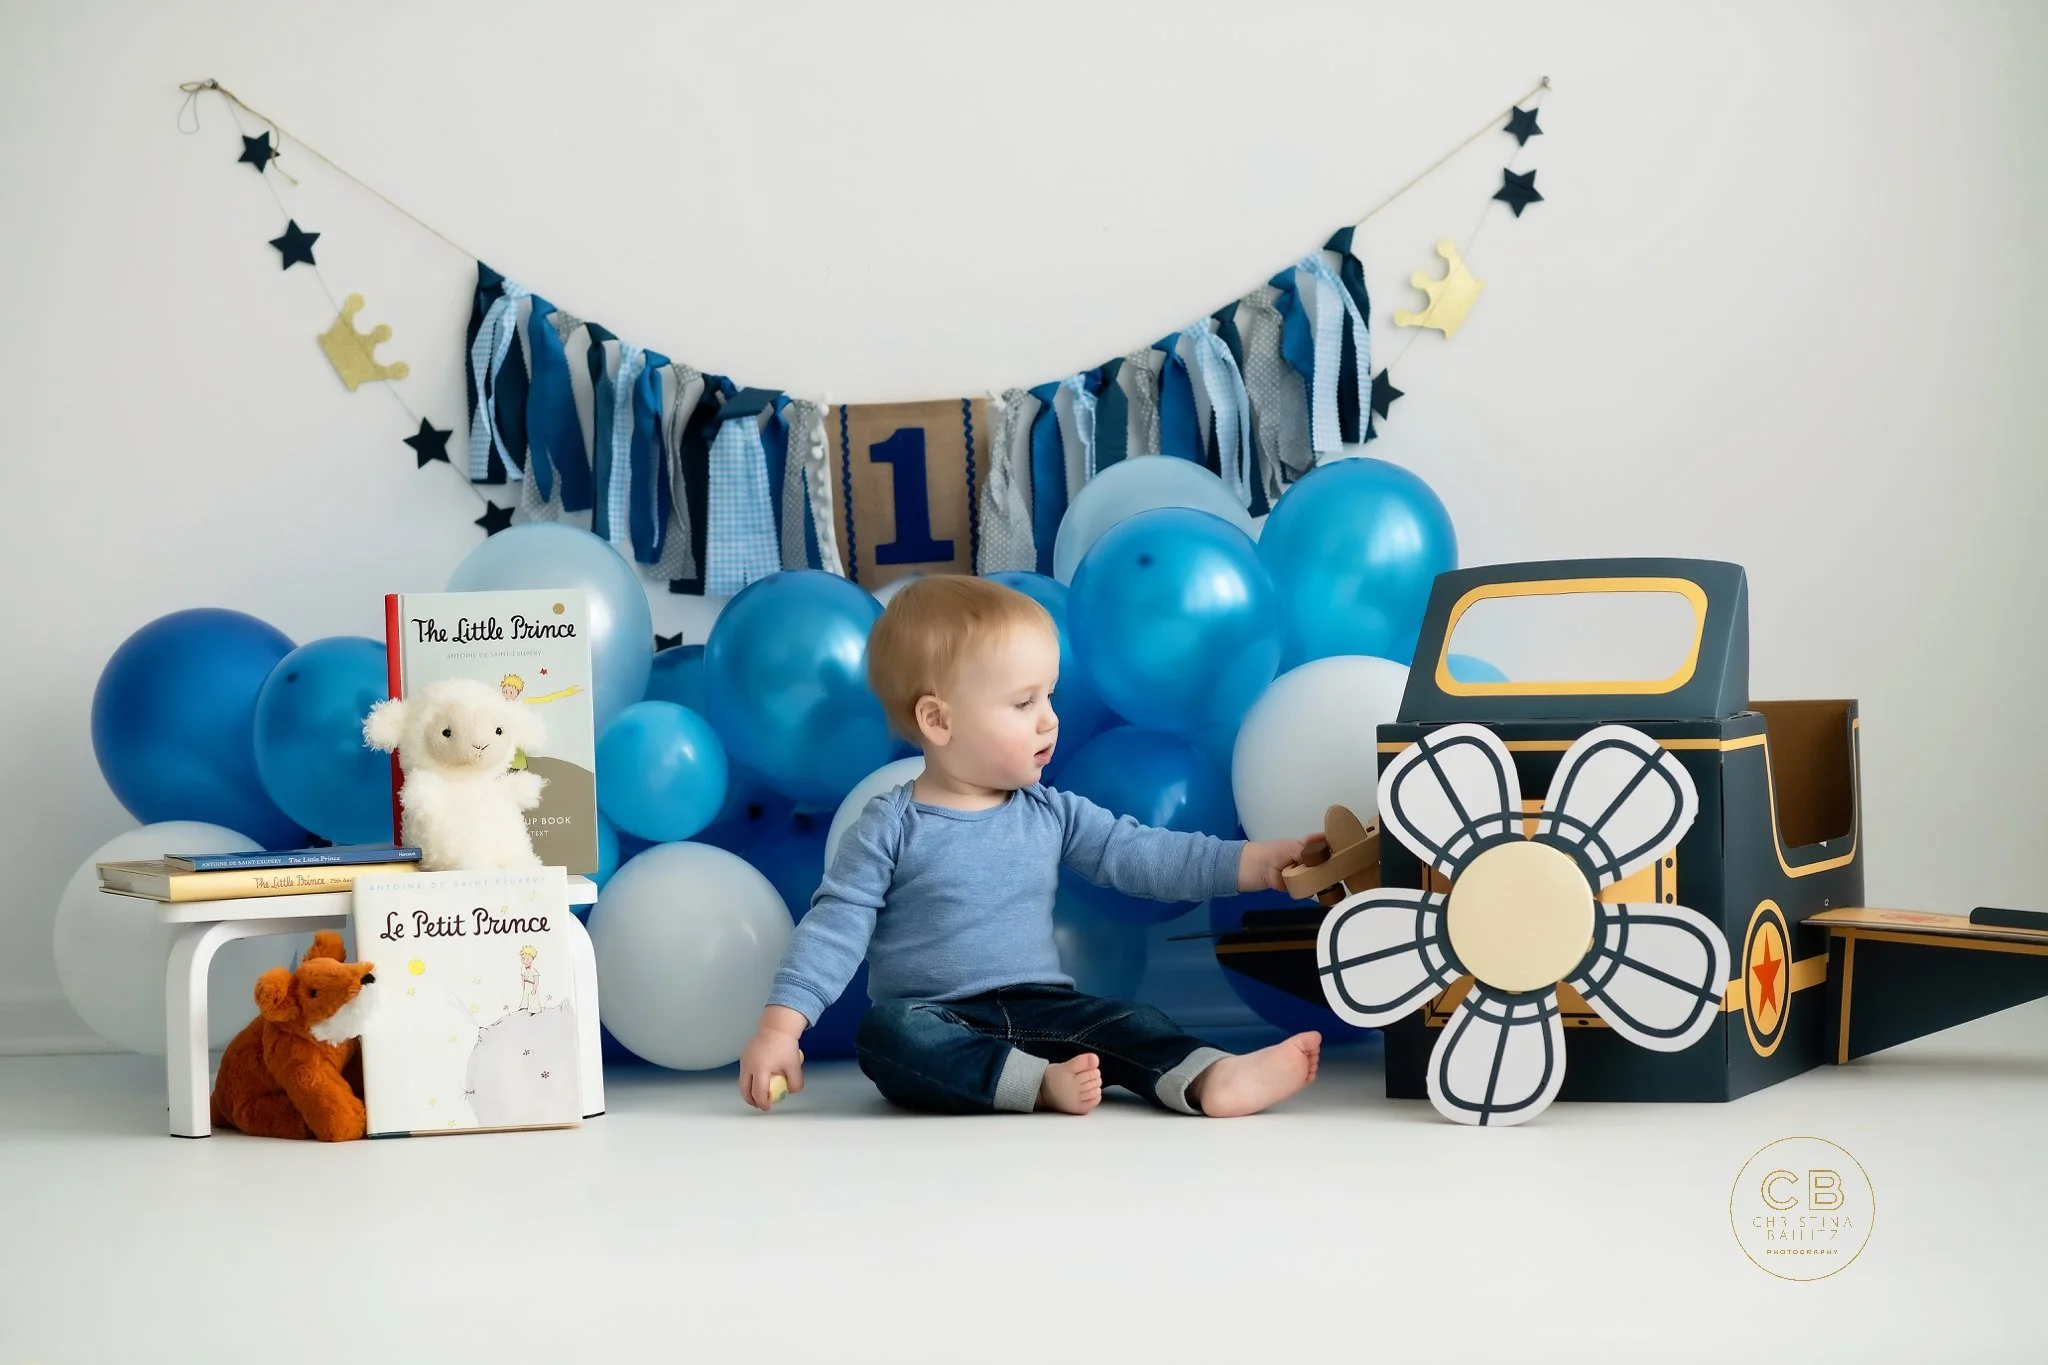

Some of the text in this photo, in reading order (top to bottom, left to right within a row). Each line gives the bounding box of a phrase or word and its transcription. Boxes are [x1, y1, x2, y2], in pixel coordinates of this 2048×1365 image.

[869, 427, 955, 565] 1
[411, 614, 577, 644] The Little Prince
[446, 652, 476, 660] ANTOINE
[541, 816, 571, 825] BOOK
[288, 856, 302, 864] The
[253, 877, 270, 889] The
[270, 875, 295, 889] Little
[296, 874, 326, 887] Prince
[369, 882, 423, 891] ANTOINE
[379, 907, 550, 941] Le Petit Prince
